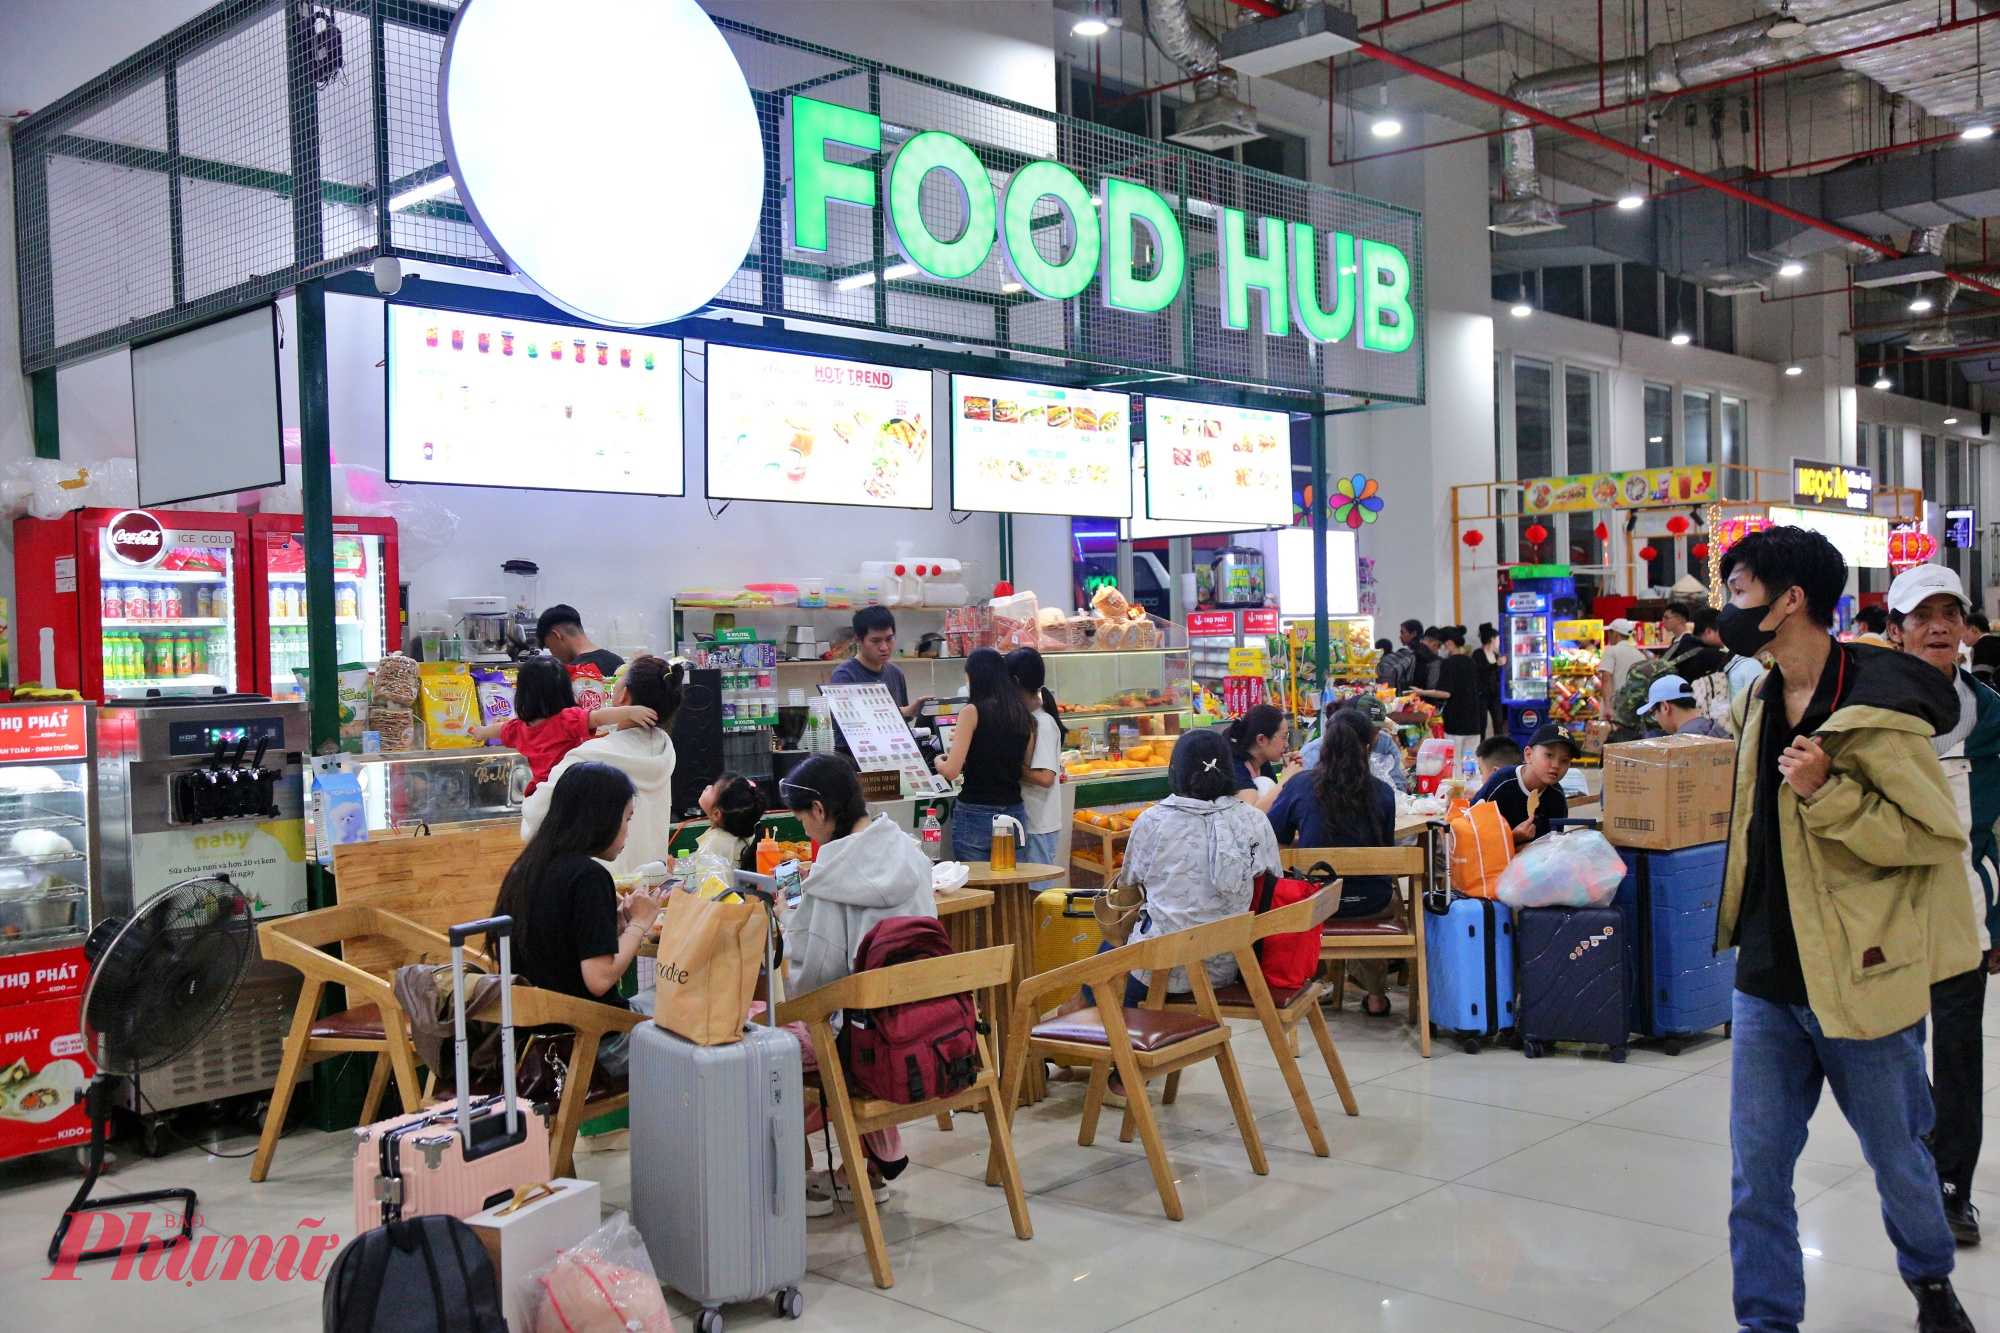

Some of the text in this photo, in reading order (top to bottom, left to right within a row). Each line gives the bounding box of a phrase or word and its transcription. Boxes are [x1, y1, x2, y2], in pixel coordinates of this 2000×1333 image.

[788, 95, 1415, 354] FOOD HUB
[814, 365, 844, 383] HOT
[847, 368, 892, 389] TREND
[1799, 467, 1833, 504] NGỌC
[112, 529, 163, 546] Coca-Cola
[178, 534, 233, 544] ICE COLD
[0, 711, 69, 732] HỌ PHÁT
[1558, 725, 1570, 739] K
[10, 745, 31, 754] TOÀN
[194, 830, 250, 850] naby
[169, 857, 276, 875] Sữa chua tươi và hơn 20 vị kem
[238, 869, 255, 879] ngày
[0, 963, 78, 989] THỌ PHÁT
[49, 985, 67, 993] KIDO
[5, 1027, 40, 1045] PHÁT
[58, 1126, 84, 1139] KIDO
